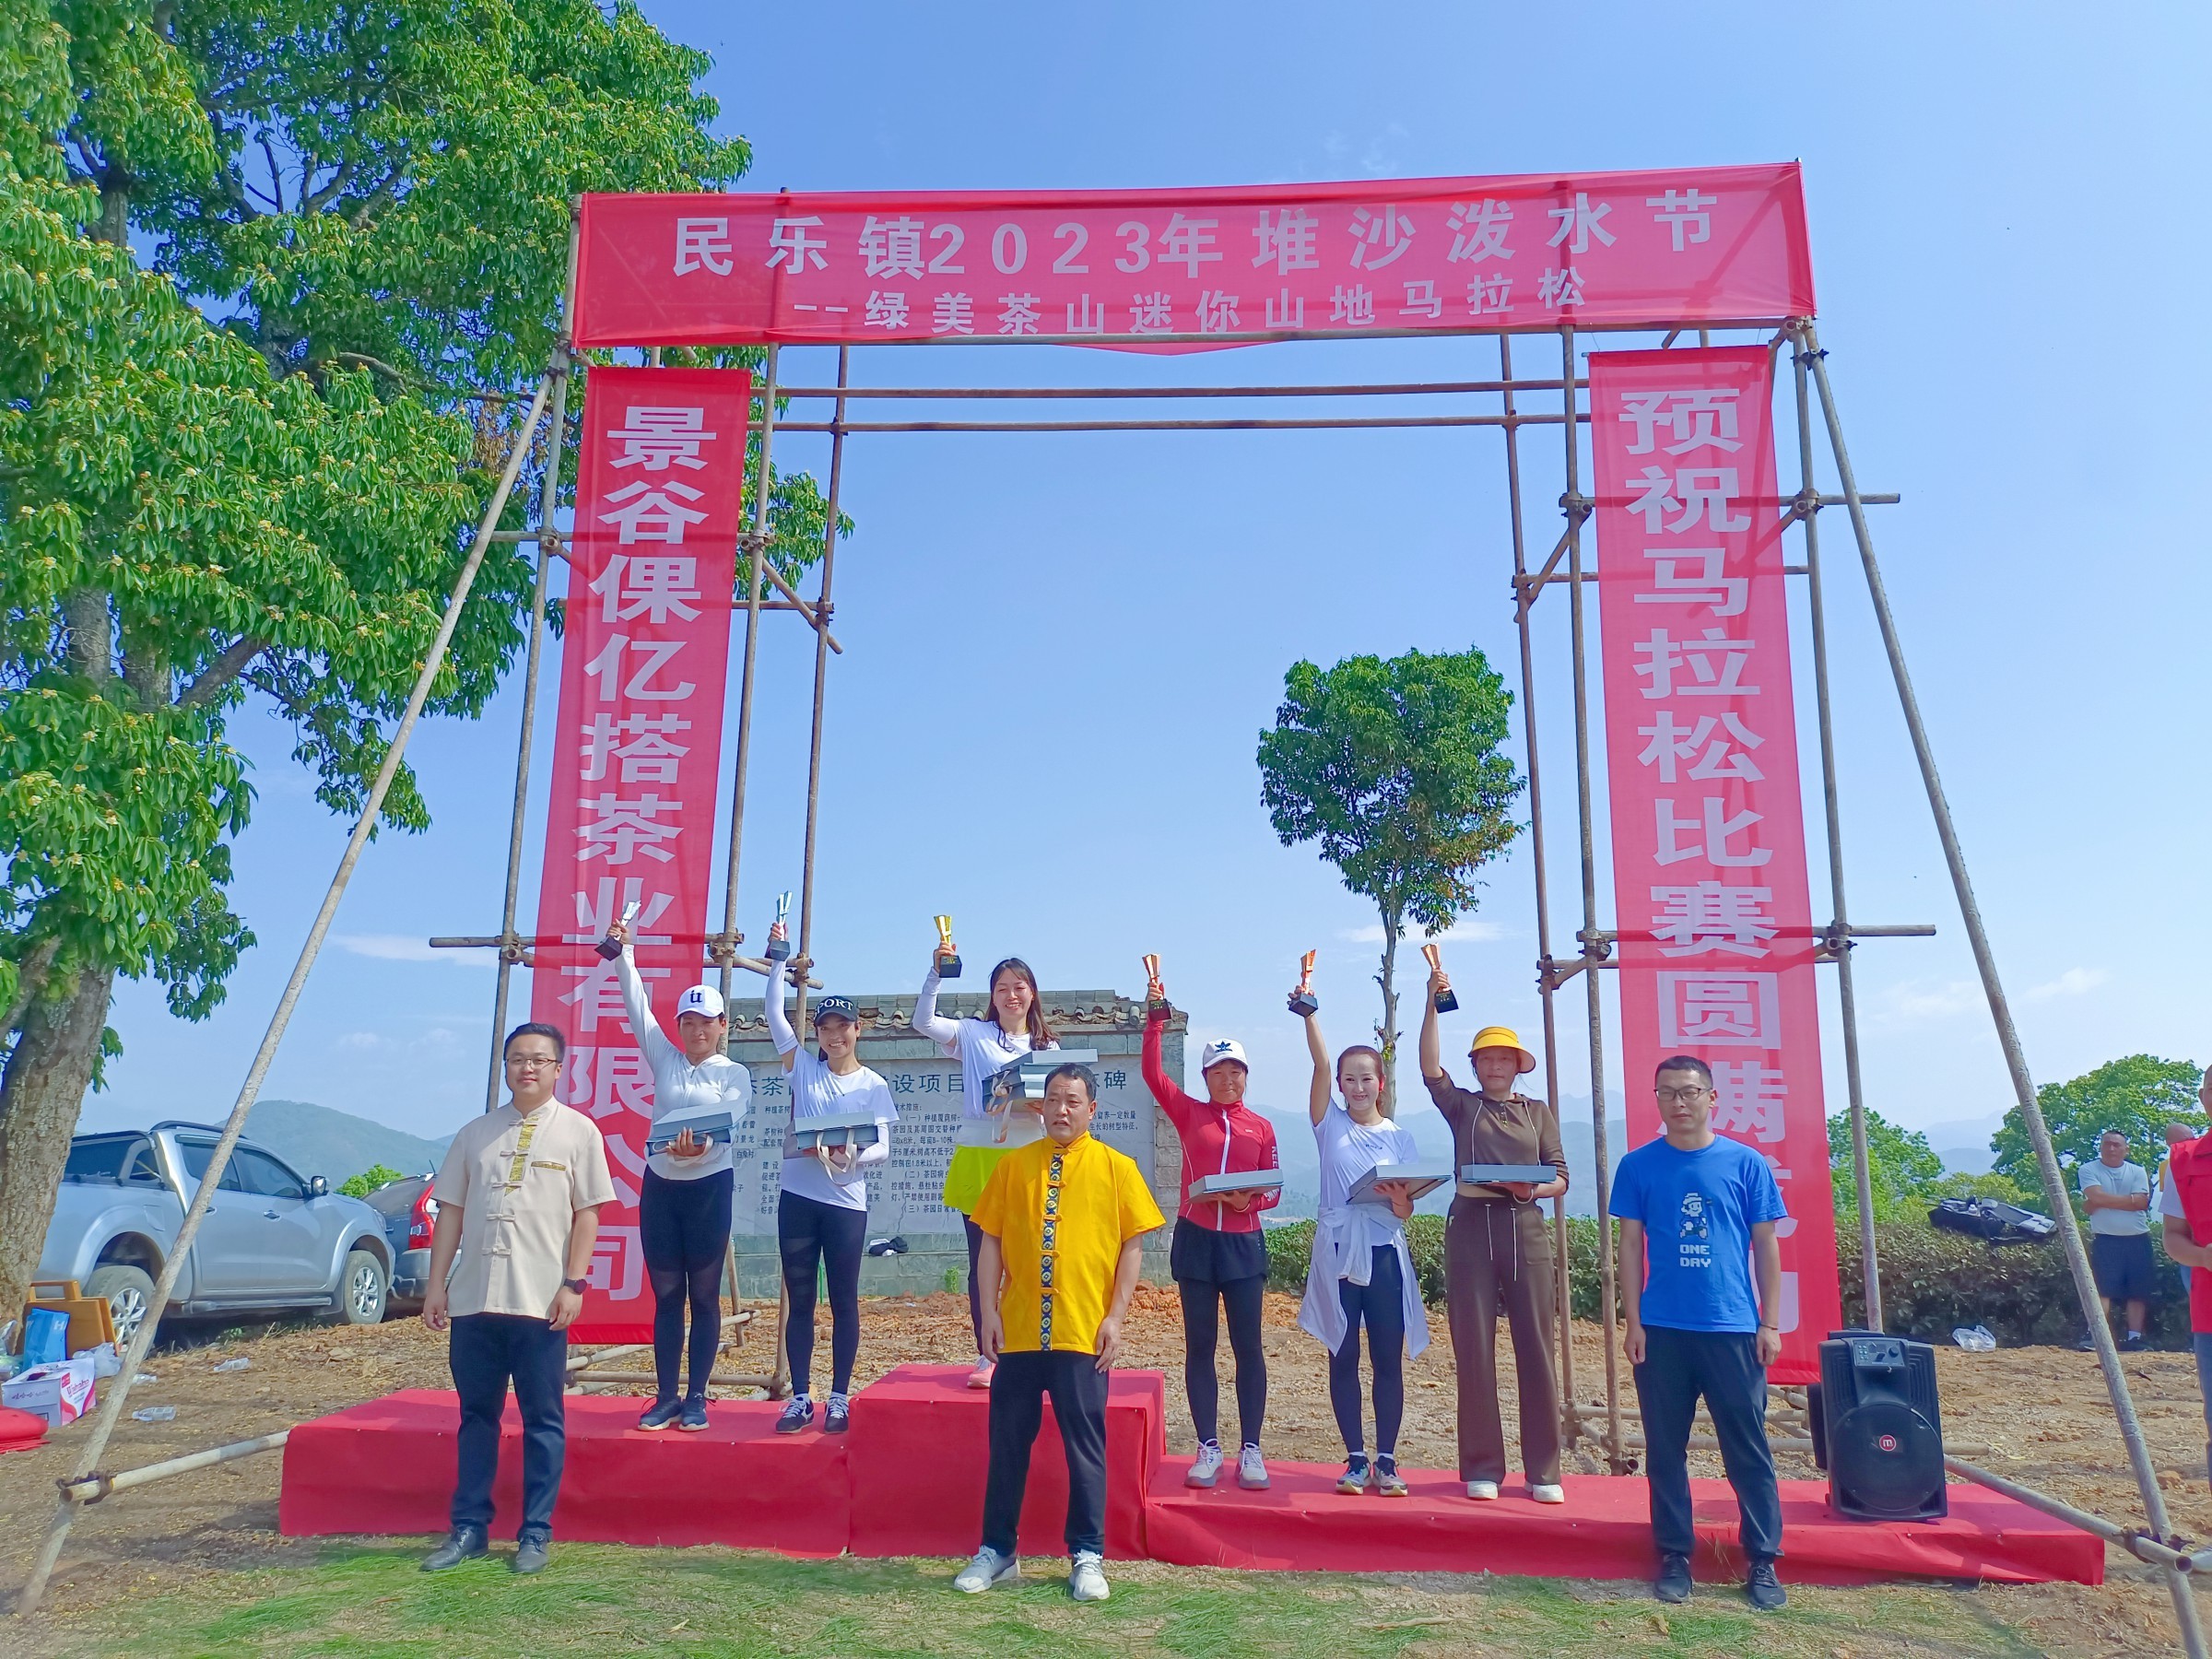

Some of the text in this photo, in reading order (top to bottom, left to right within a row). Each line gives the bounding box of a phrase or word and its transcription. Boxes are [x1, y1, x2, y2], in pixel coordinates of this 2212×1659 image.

[673, 188, 1718, 280] 民乐镇2023年堆沙泼水节
[1618, 387, 1799, 1335] 预祝马拉松比赛圆满
[885, 1074, 964, 1094] 设项目
[1679, 1244, 1711, 1254] ONE
[1679, 1257, 1712, 1268] DAY
